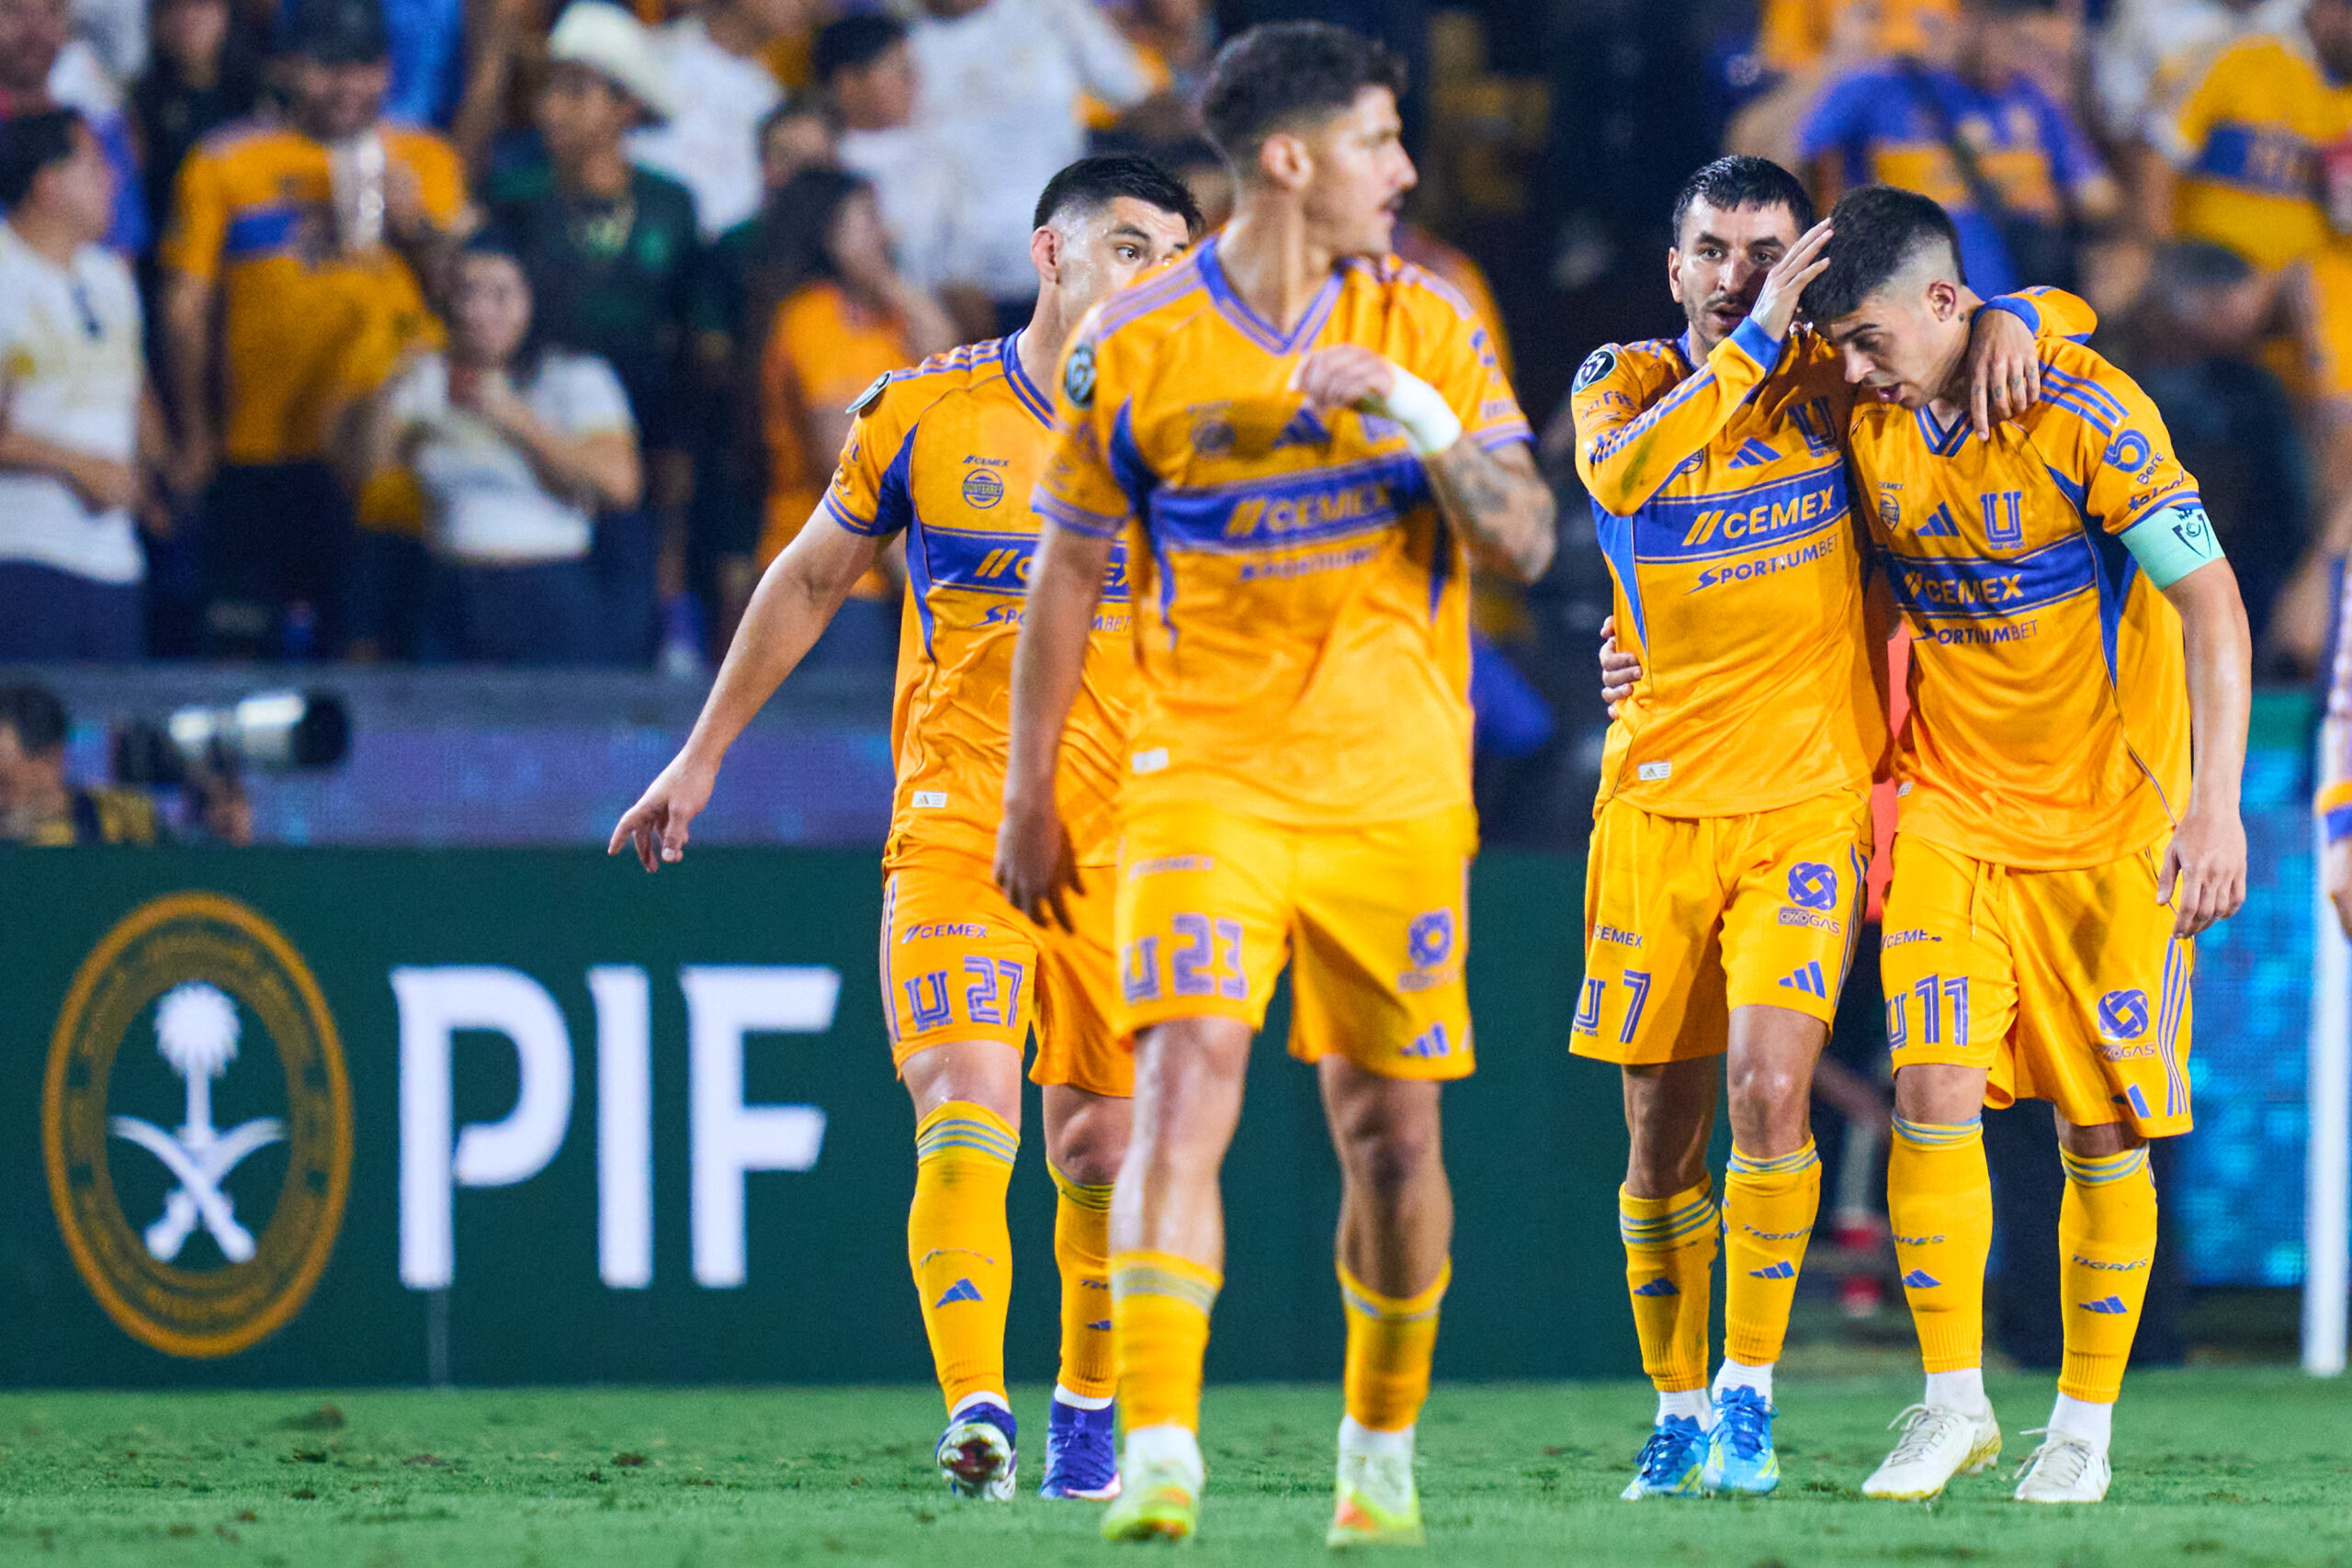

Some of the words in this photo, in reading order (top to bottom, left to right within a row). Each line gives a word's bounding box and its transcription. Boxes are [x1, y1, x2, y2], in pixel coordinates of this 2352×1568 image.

[1724, 485, 1834, 539] CEMEX
[1980, 491, 2022, 543] U
[1683, 532, 1838, 595] SPORTIUMBET
[1925, 573, 2024, 604] CEMEX
[921, 923, 988, 939] CEMEX
[1171, 913, 1250, 1001] 23
[1595, 924, 1643, 948] CEMEX
[904, 970, 950, 1026] U
[964, 954, 1023, 1029] 27
[1619, 968, 1651, 1043] 7
[1915, 974, 1968, 1046] 11
[389, 964, 842, 1289] PIF
